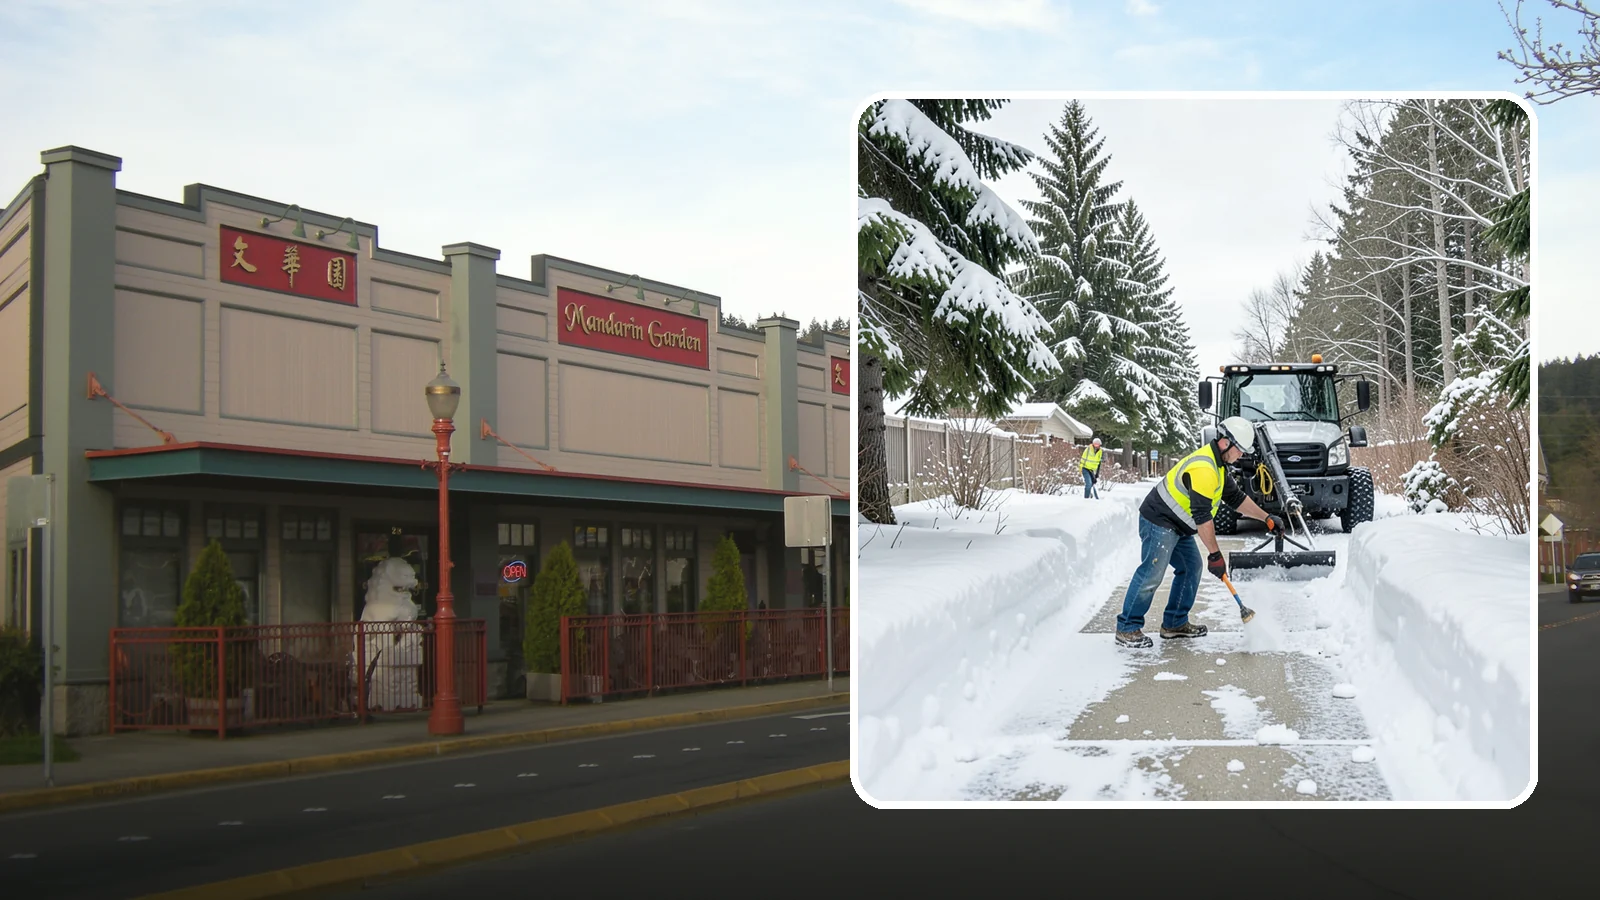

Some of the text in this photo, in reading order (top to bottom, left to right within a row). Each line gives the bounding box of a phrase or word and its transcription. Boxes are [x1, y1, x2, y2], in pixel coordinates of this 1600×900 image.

[231, 236, 346, 291] 文華園
[564, 302, 701, 352] Mandarin Garden
[503, 565, 527, 578] OPEN
